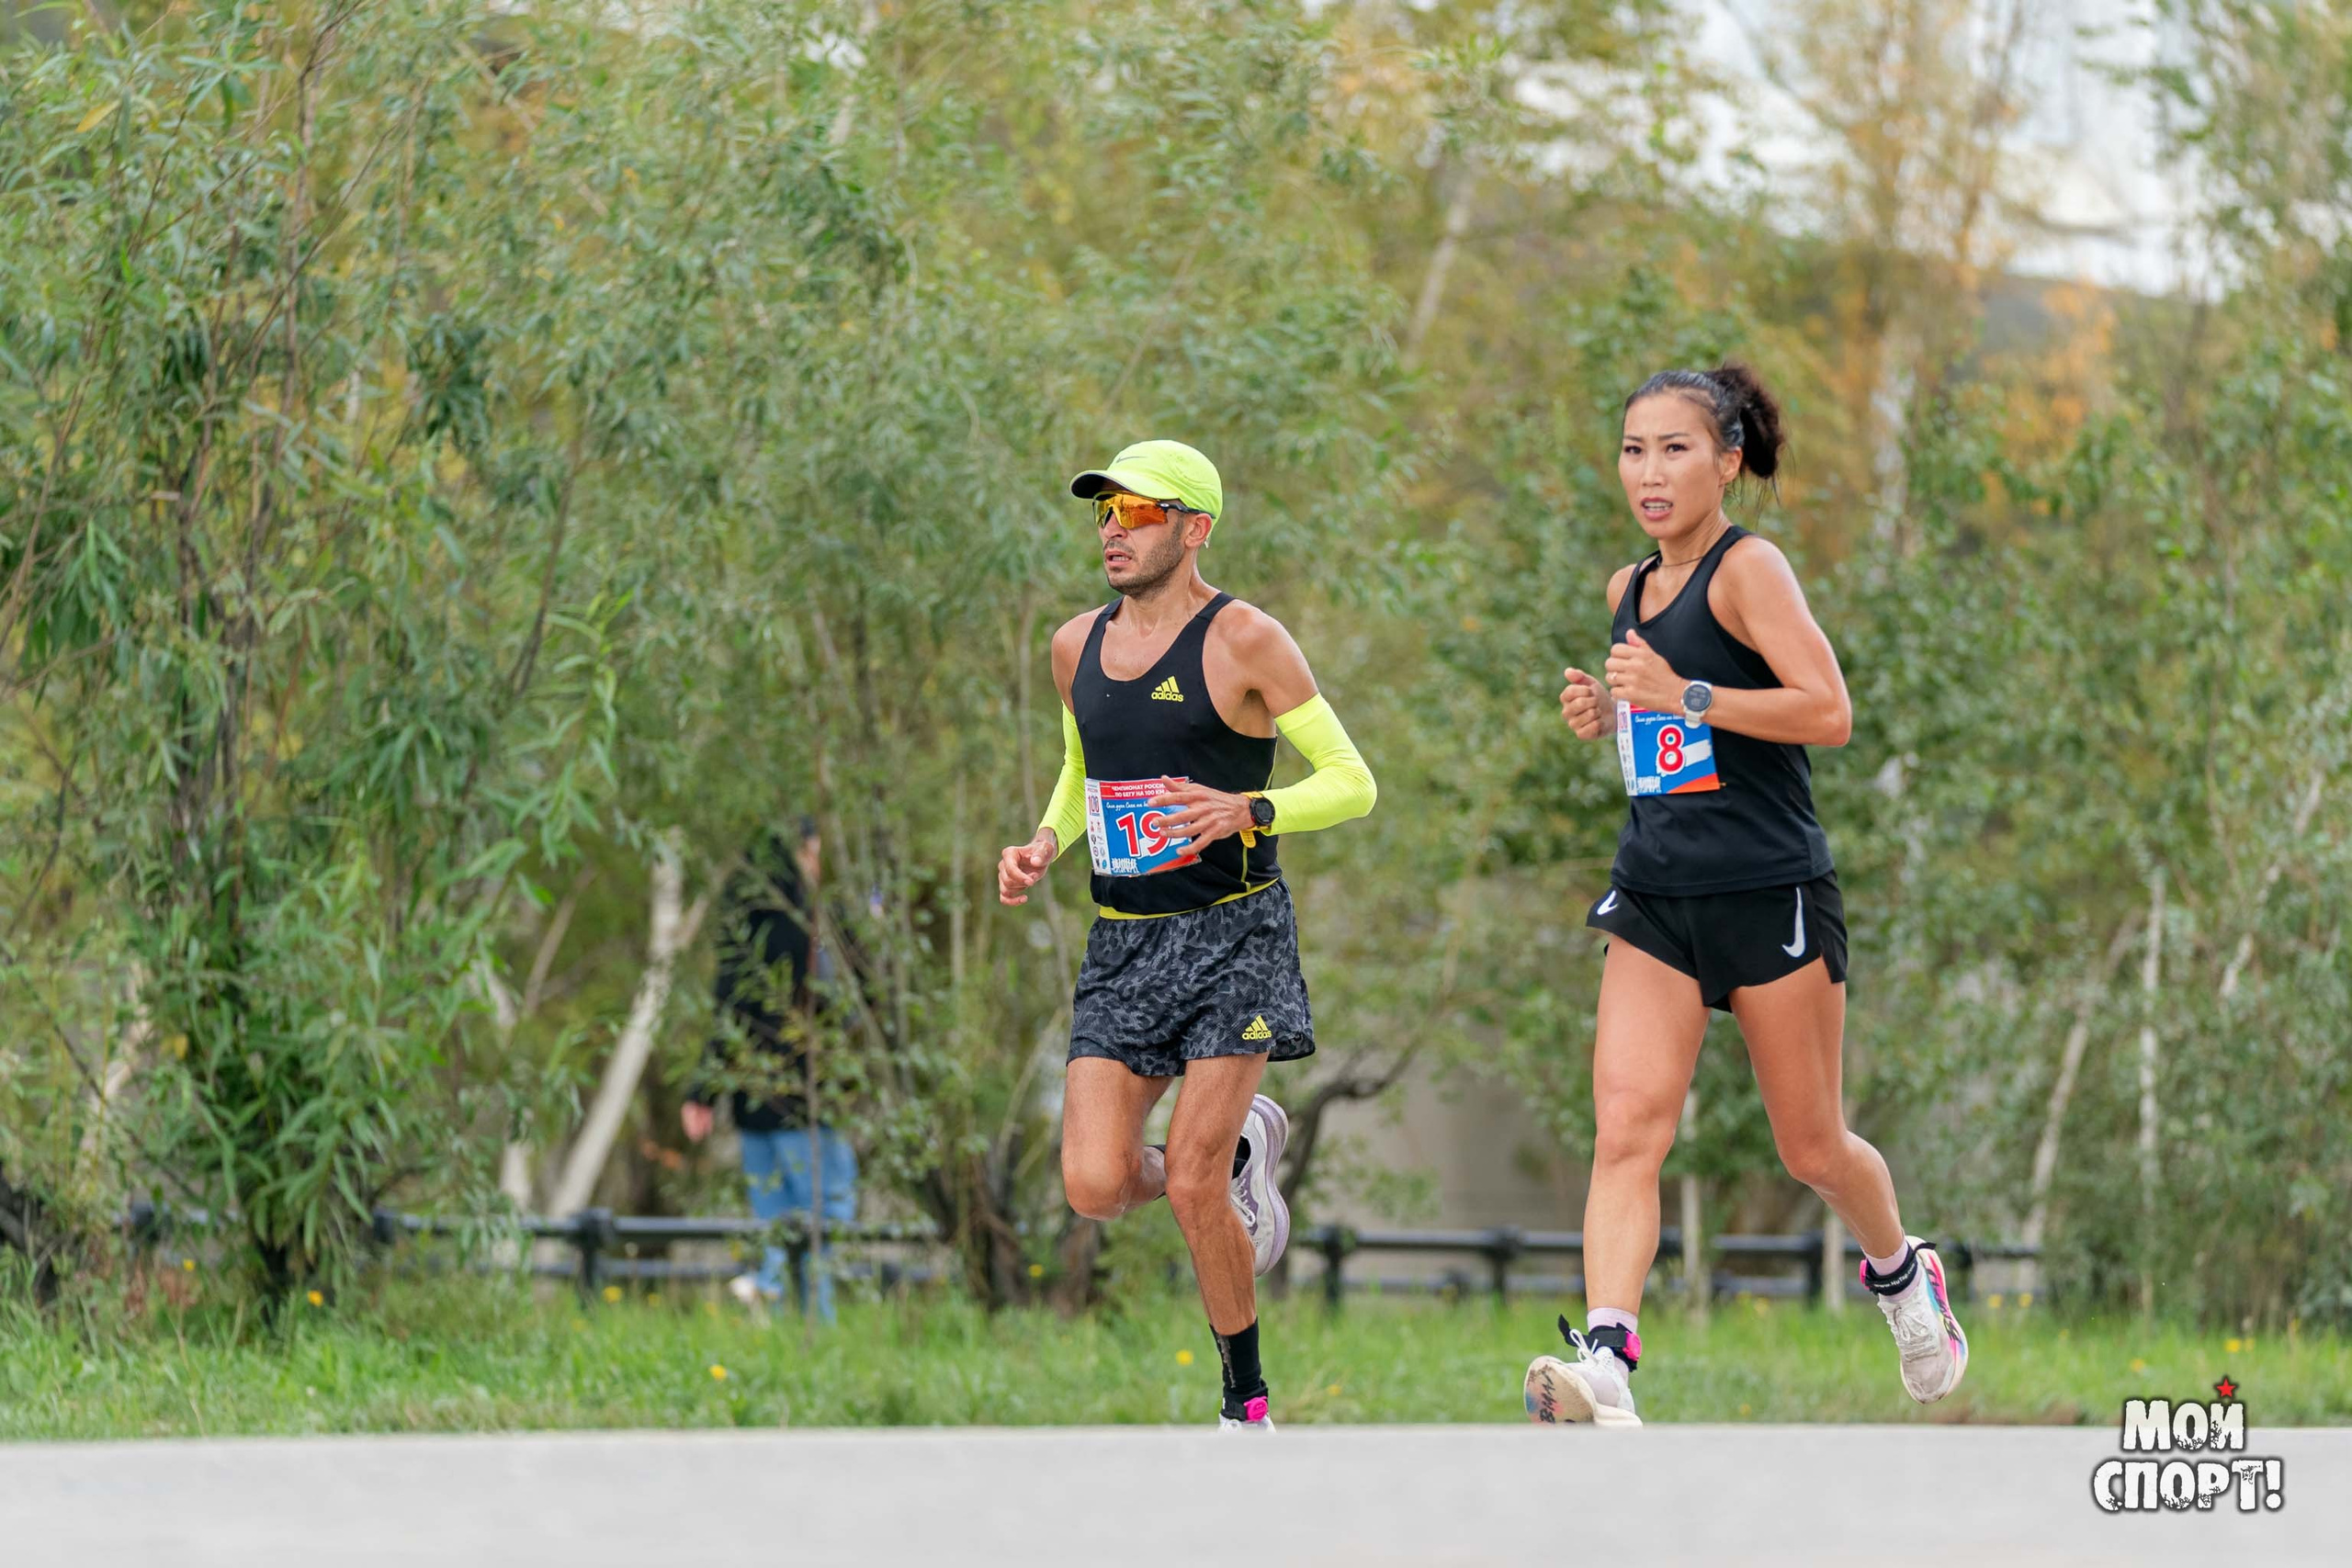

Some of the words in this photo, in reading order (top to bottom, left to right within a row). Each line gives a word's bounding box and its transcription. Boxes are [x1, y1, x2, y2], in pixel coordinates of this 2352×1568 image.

[1151, 691, 1184, 702] adidas
[1657, 725, 1684, 774] 8
[1116, 811, 1170, 857] 19
[1241, 1030, 1272, 1041] adidas
